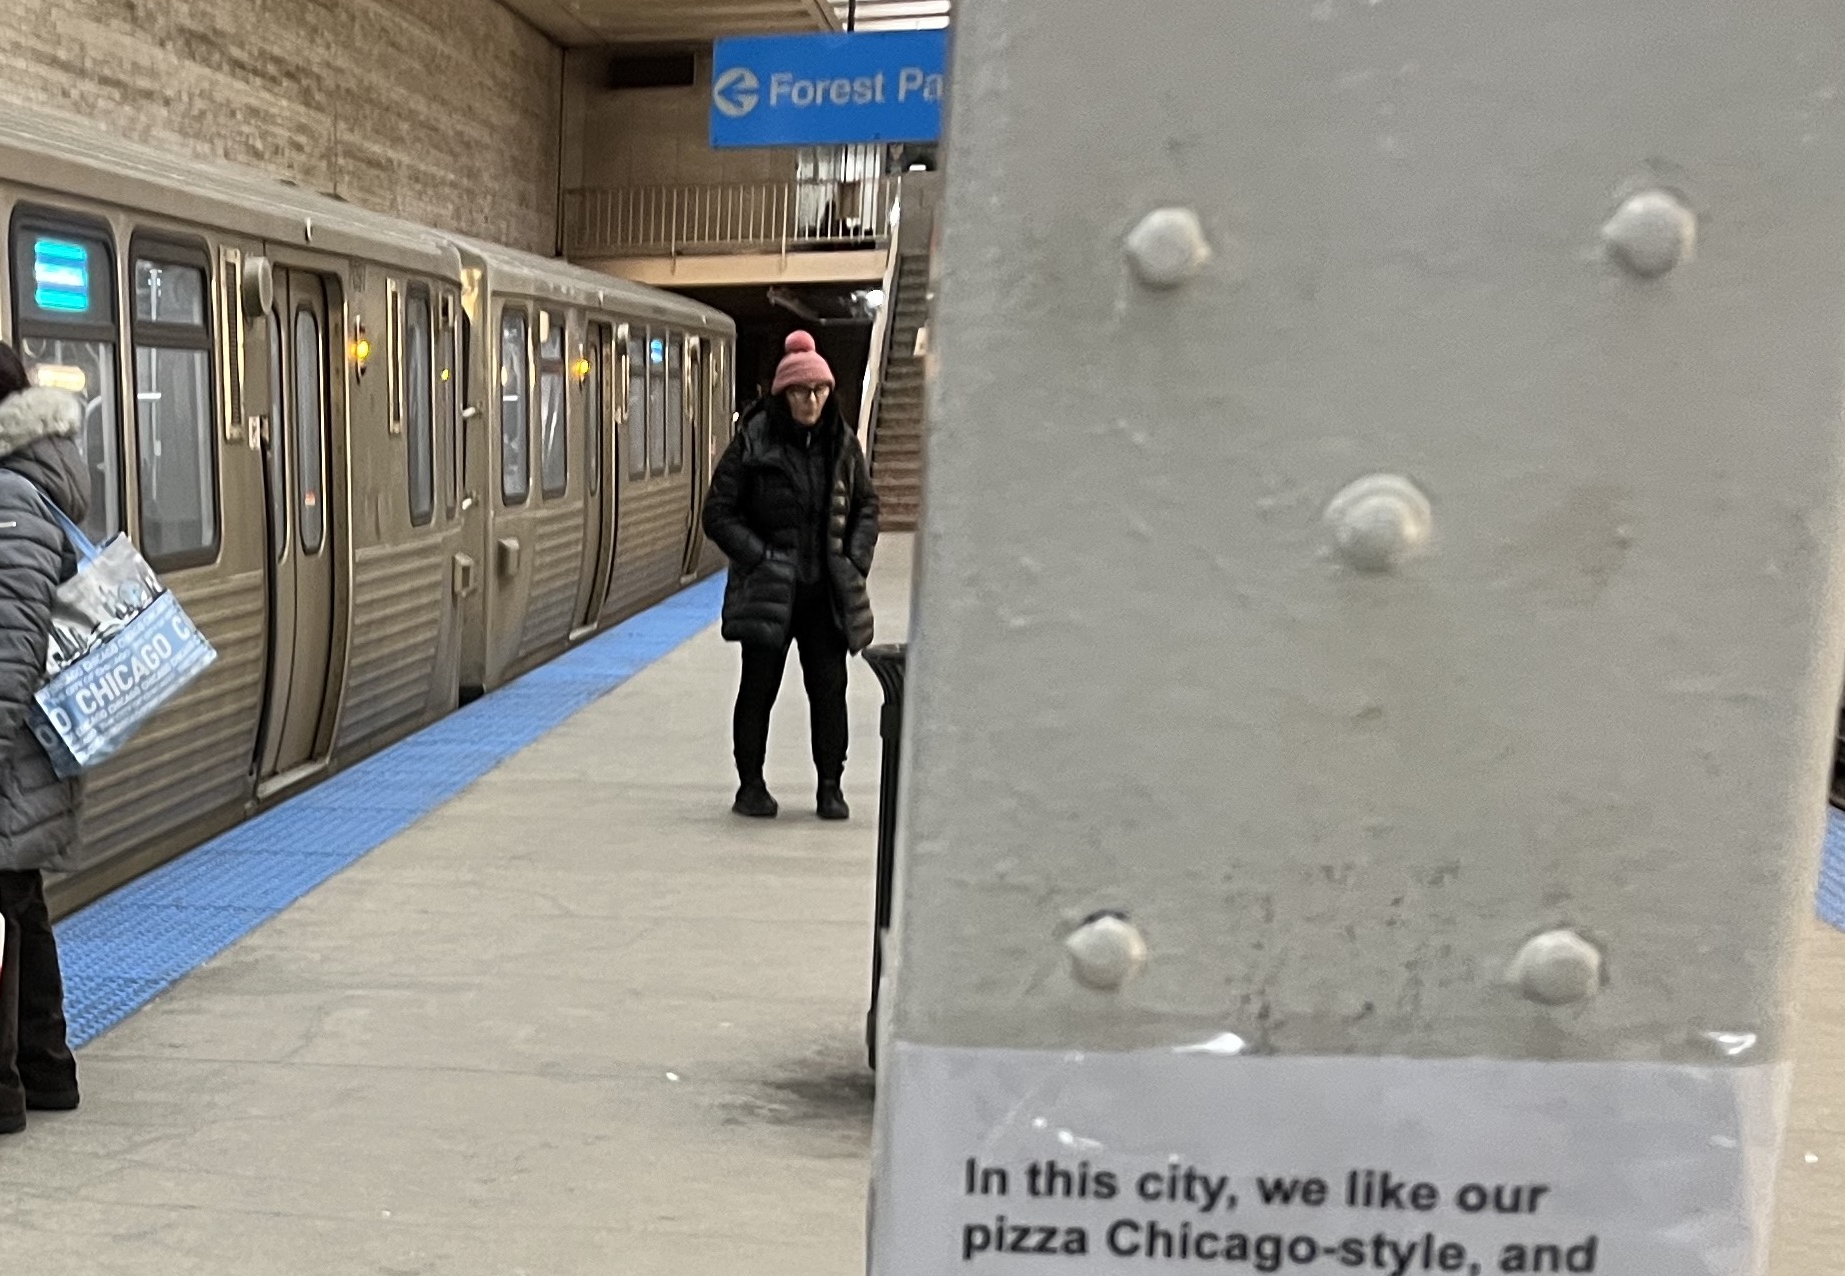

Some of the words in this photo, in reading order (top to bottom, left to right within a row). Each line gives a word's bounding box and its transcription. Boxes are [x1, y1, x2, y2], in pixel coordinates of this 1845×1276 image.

[768, 70, 885, 108] Forest
[74, 631, 173, 715] CHICAGO
[965, 1157, 1008, 1196] In
[1024, 1159, 1120, 1200] this
[1134, 1162, 1239, 1214] city,
[1256, 1176, 1329, 1207] we
[1346, 1168, 1441, 1212] like
[1455, 1181, 1550, 1215] our
[962, 1214, 1090, 1261] pizza
[1499, 1234, 1599, 1274] and
